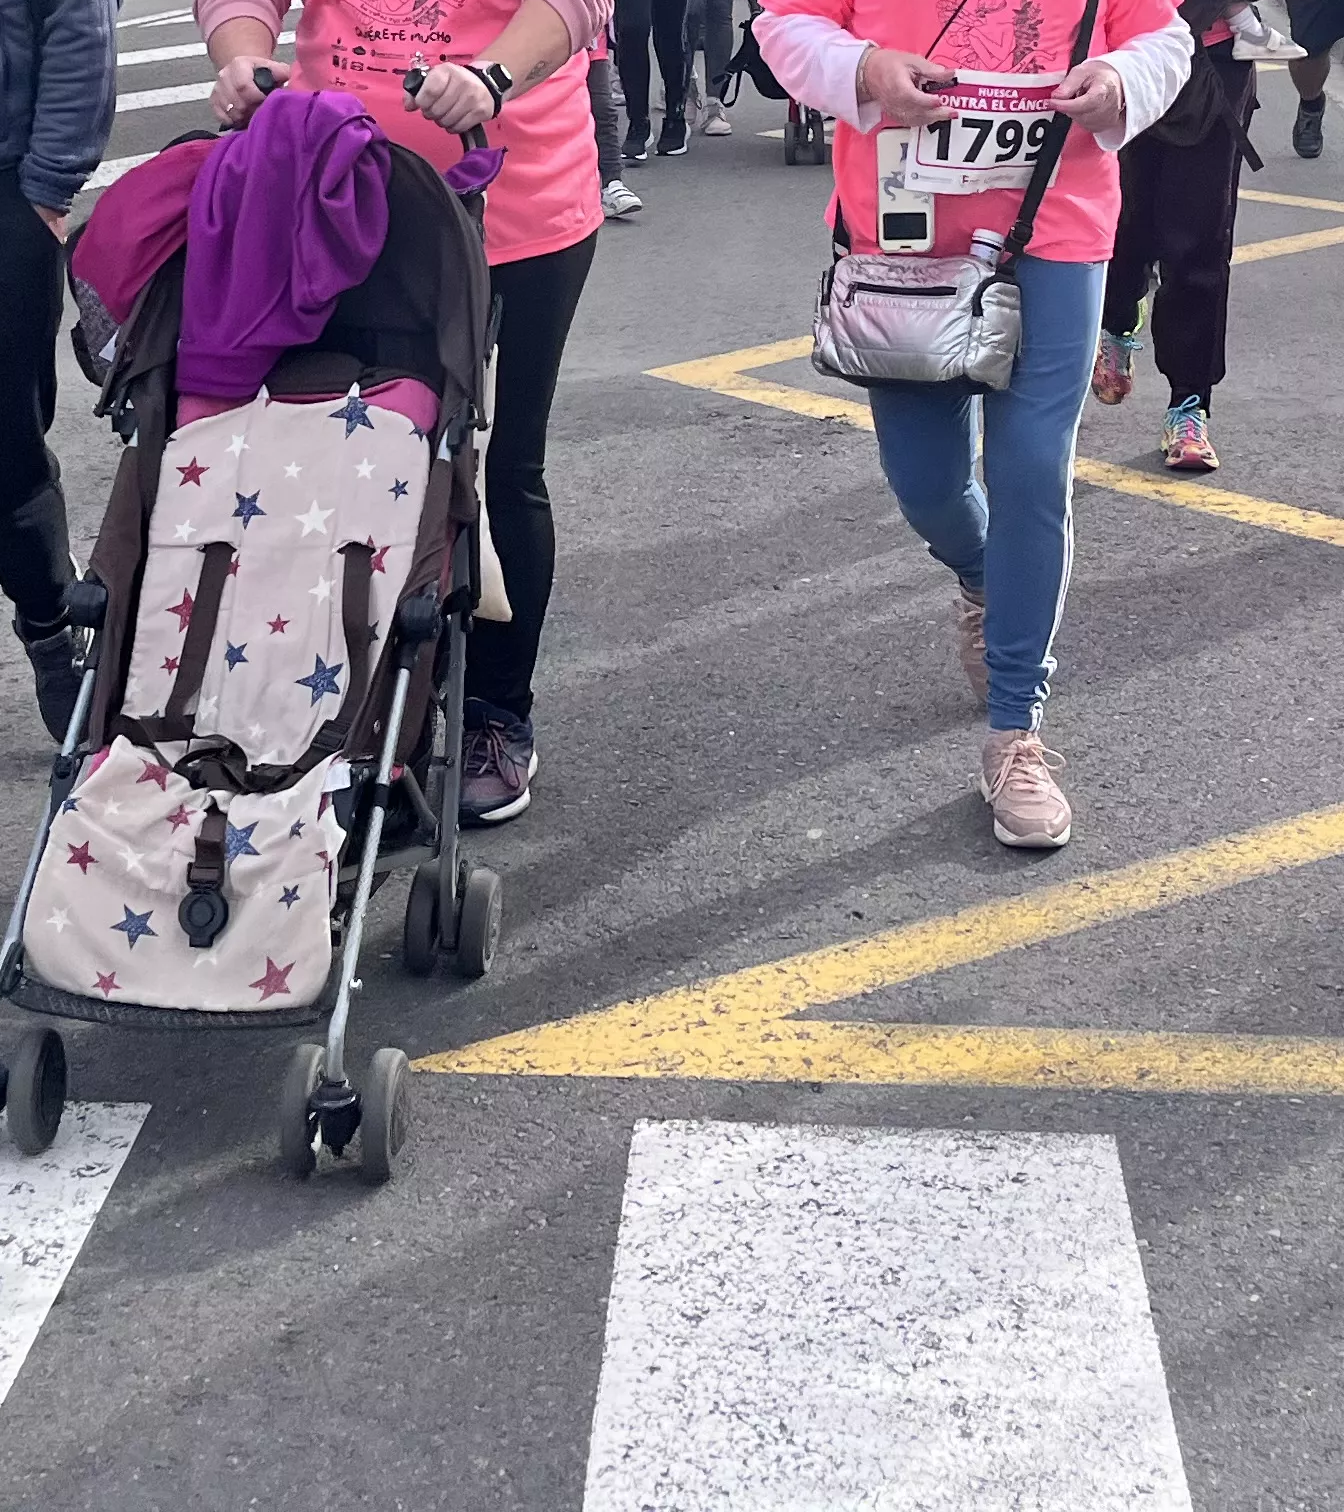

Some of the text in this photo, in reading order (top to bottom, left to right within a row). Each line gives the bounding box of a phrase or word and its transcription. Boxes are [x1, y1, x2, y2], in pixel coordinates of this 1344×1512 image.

[410, 31, 452, 44] MUCHO
[978, 87, 1019, 99] HUESCA
[991, 99, 1006, 111] EL
[1009, 97, 1050, 112] CÁNCE
[926, 116, 1052, 164] 1799
